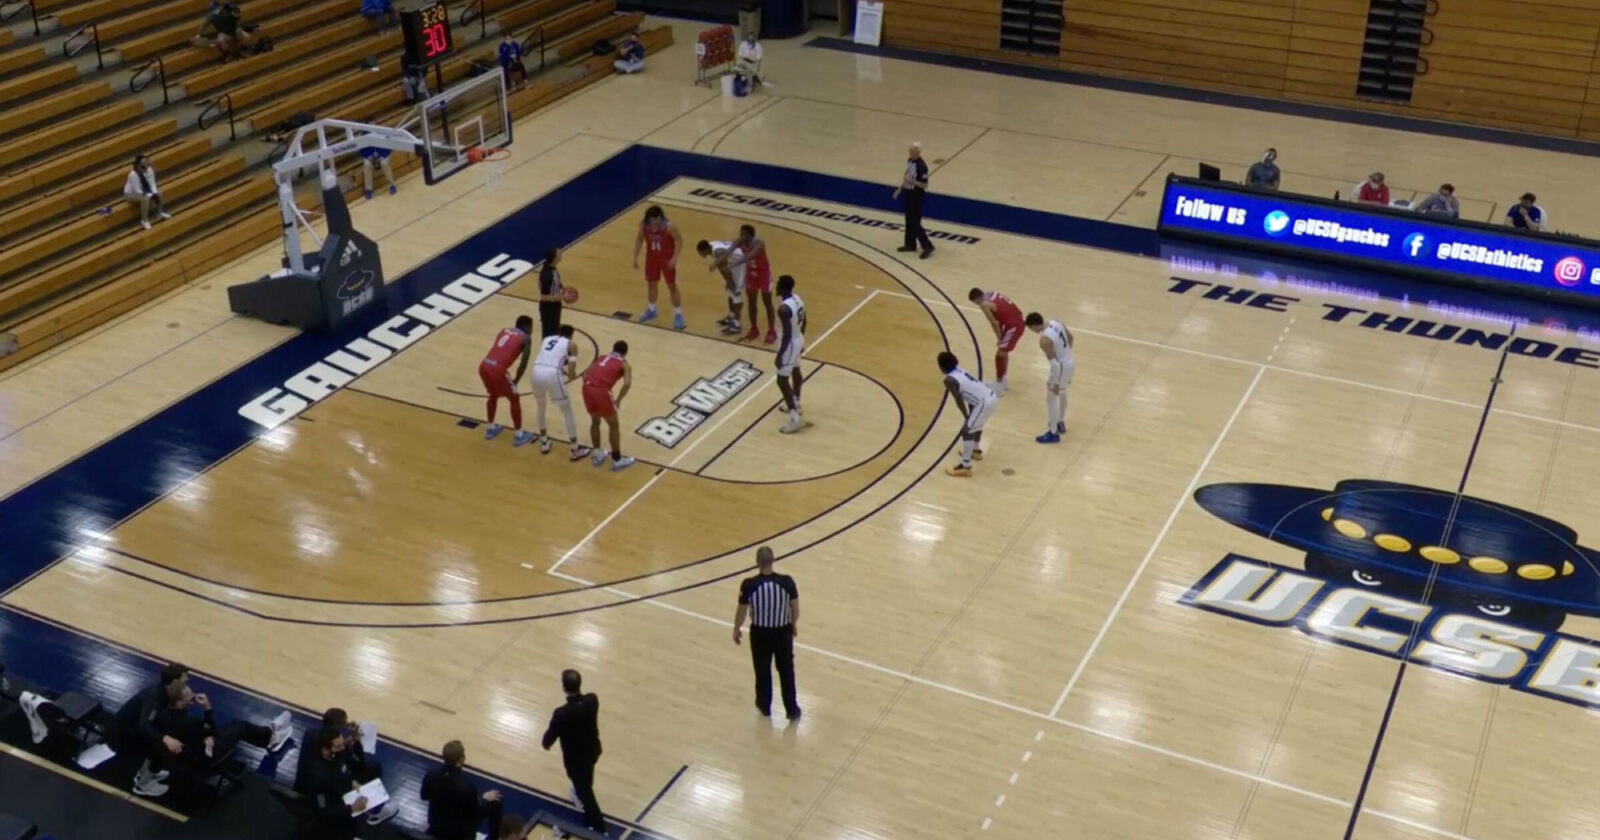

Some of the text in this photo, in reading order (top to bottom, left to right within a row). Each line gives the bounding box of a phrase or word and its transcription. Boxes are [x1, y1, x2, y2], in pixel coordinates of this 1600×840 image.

[422, 5, 445, 28] 3:28
[423, 23, 447, 57] 30
[1175, 196, 1247, 226] Follow us
[1293, 218, 1391, 248] @UCSBgauchos
[1437, 242, 1544, 273] @UCSBathletics
[1167, 276, 1600, 368] THE THUNDE
[237, 253, 534, 430] GAUCHOS
[545, 339, 559, 351] 5
